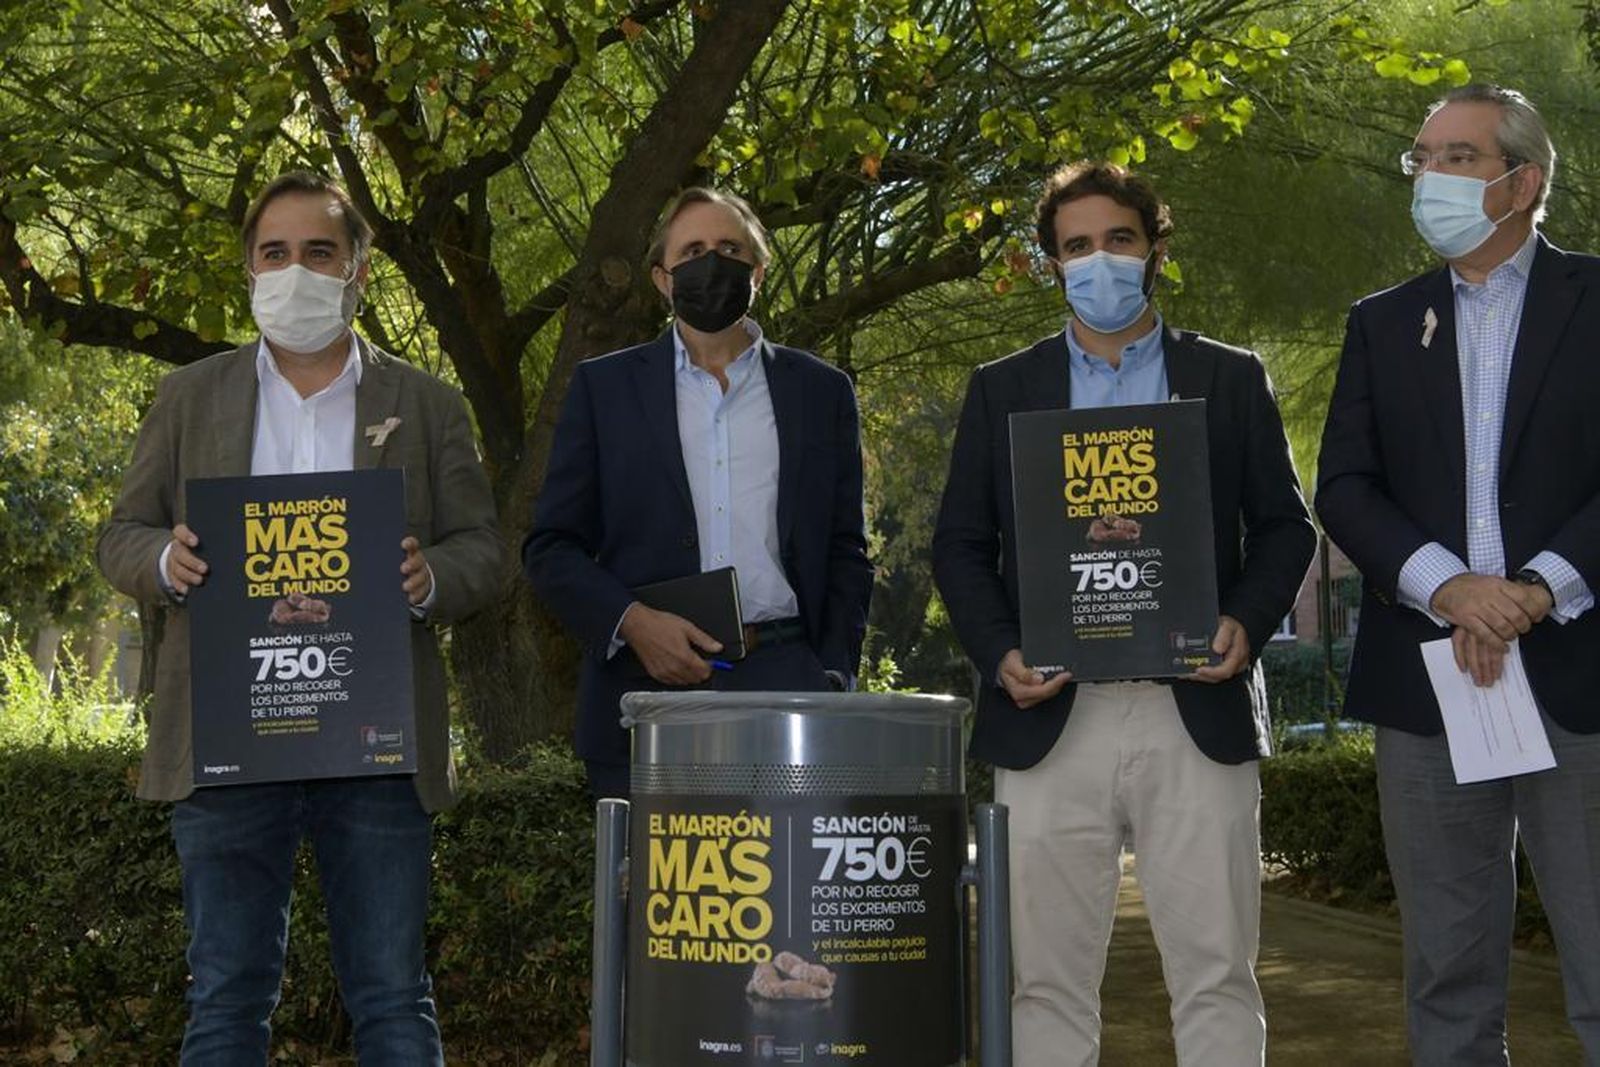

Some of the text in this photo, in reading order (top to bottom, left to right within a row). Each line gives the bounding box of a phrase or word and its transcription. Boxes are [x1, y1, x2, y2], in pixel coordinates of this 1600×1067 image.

[1063, 426, 1153, 446] EL MARRÓN
[1064, 442, 1156, 478] MÁS
[1064, 475, 1158, 504] CARO
[245, 495, 346, 517] EL MARRÓN
[1067, 500, 1158, 517] DEL MUNDO
[245, 514, 348, 553] MÁS
[1070, 548, 1162, 562] SANCIÓN DE HASTA
[245, 550, 350, 582] CARO
[1070, 560, 1162, 592] 750€
[248, 578, 350, 597] DEL MUNDO
[1072, 590, 1152, 603] POR NO RECOGER
[1073, 600, 1160, 614] LOS EXCREMENTOS
[1073, 612, 1132, 624] DE TU PERRO
[250, 632, 353, 647] SANCIÓN DE HASTA
[249, 646, 353, 681] 750€
[251, 680, 341, 694] POR NO RECOGER
[251, 691, 349, 706] LOS EXCREMENTOS
[251, 705, 318, 718] DE TU PERRO
[650, 810, 771, 837] EL MARRÓN
[812, 812, 906, 834] SANCIÓN
[908, 815, 918, 824] DE
[649, 837, 772, 895] MÁS
[812, 836, 932, 881] 750€
[812, 884, 919, 899] POR NO RECOGER
[647, 892, 773, 940] CARO
[812, 900, 926, 915] LOS EXCREMENTOS
[812, 918, 895, 933] DE TU PERRO
[648, 937, 772, 964] DEL MUNDO
[831, 1042, 866, 1057] inagra
